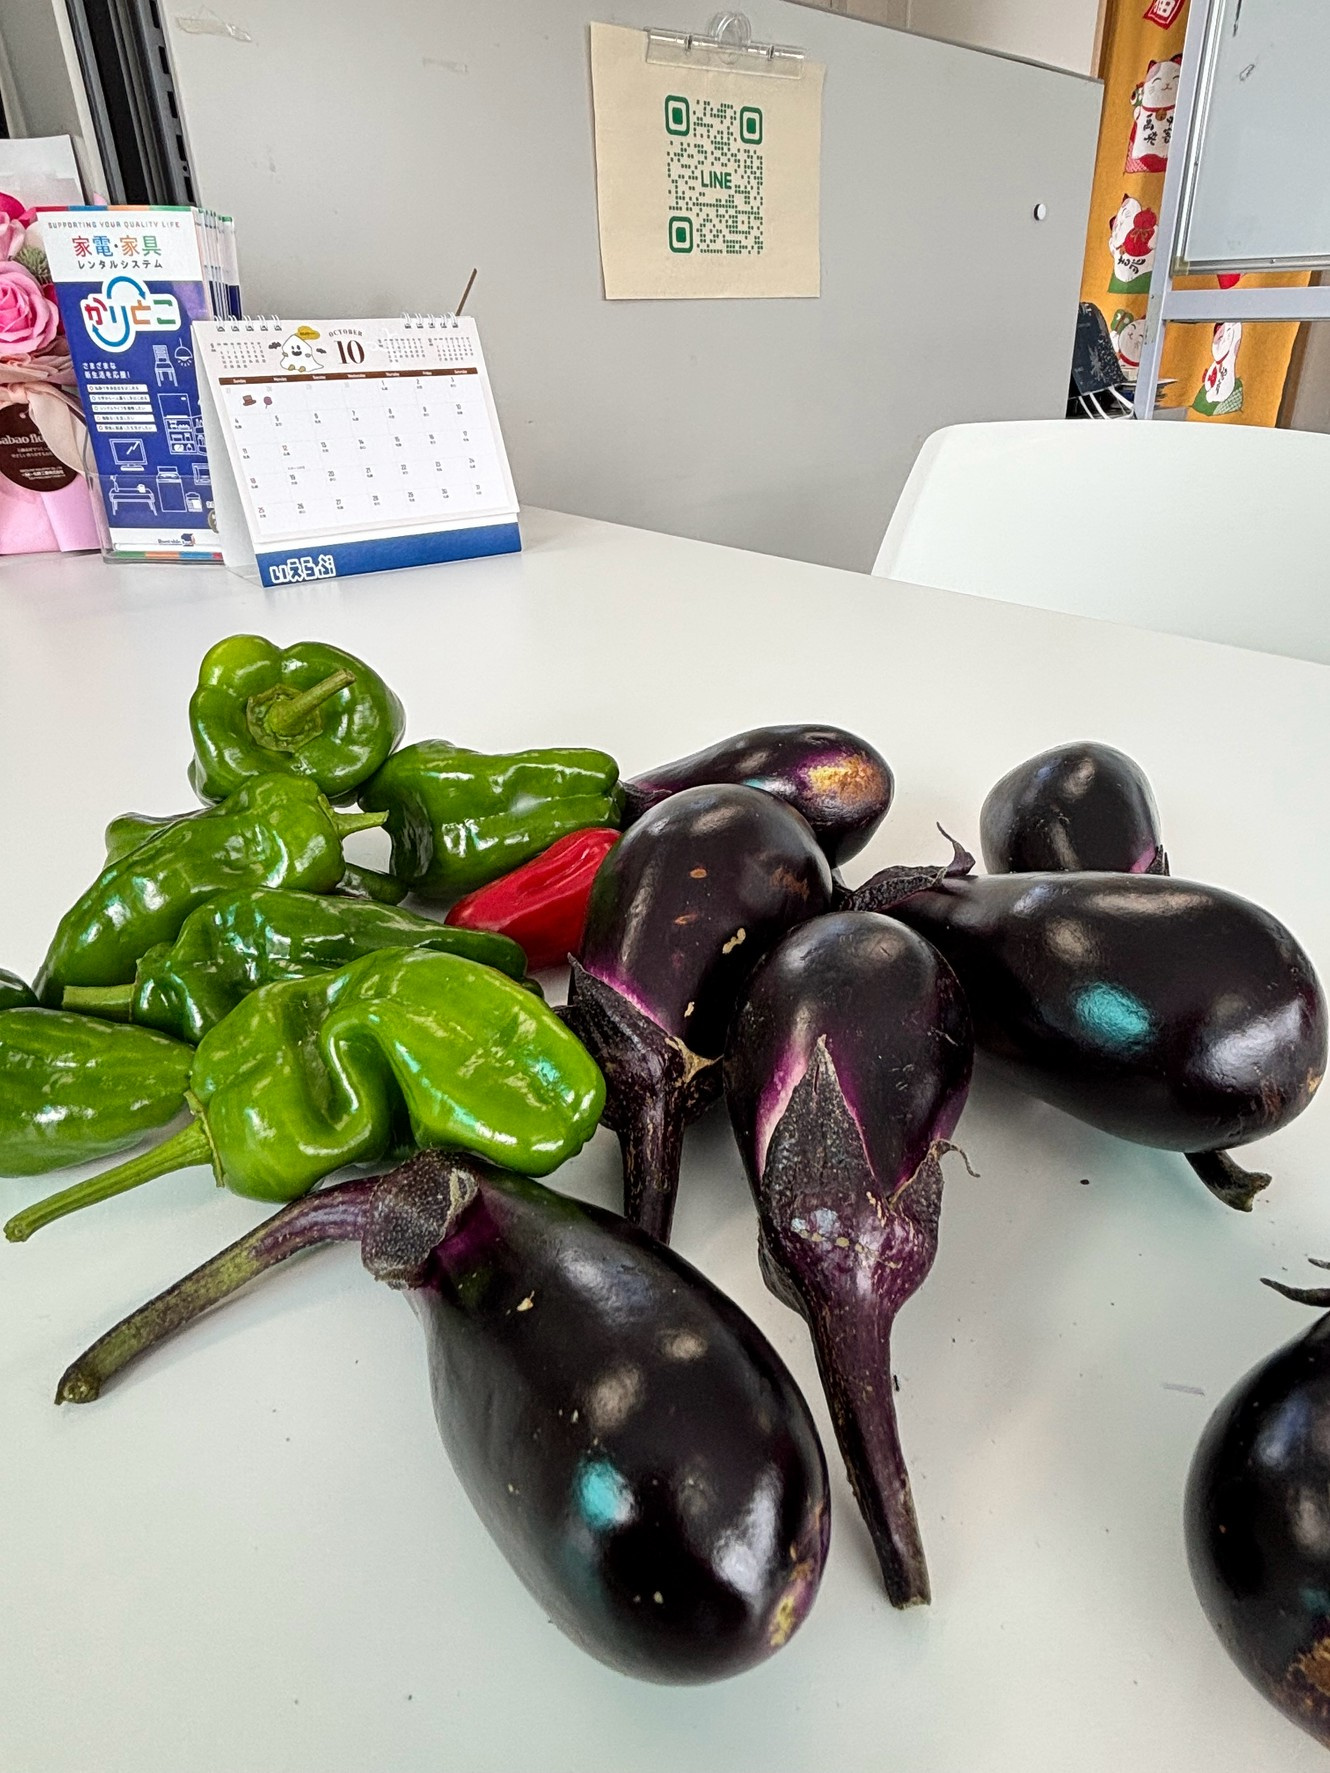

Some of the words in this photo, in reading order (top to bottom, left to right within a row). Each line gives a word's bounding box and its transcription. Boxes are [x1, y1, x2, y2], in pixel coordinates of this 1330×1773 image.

[700, 169, 732, 190] LINE
[48, 221, 97, 229] SUPPORTING
[124, 221, 158, 229] QUALITY
[72, 235, 162, 257] 家電・家具
[77, 259, 163, 269] レンタルシステム
[84, 297, 177, 347] かりとこ
[328, 329, 363, 337] OCTOBER
[334, 340, 365, 364] 10
[0, 434, 30, 445] abao
[269, 554, 336, 583] いえらぶ
